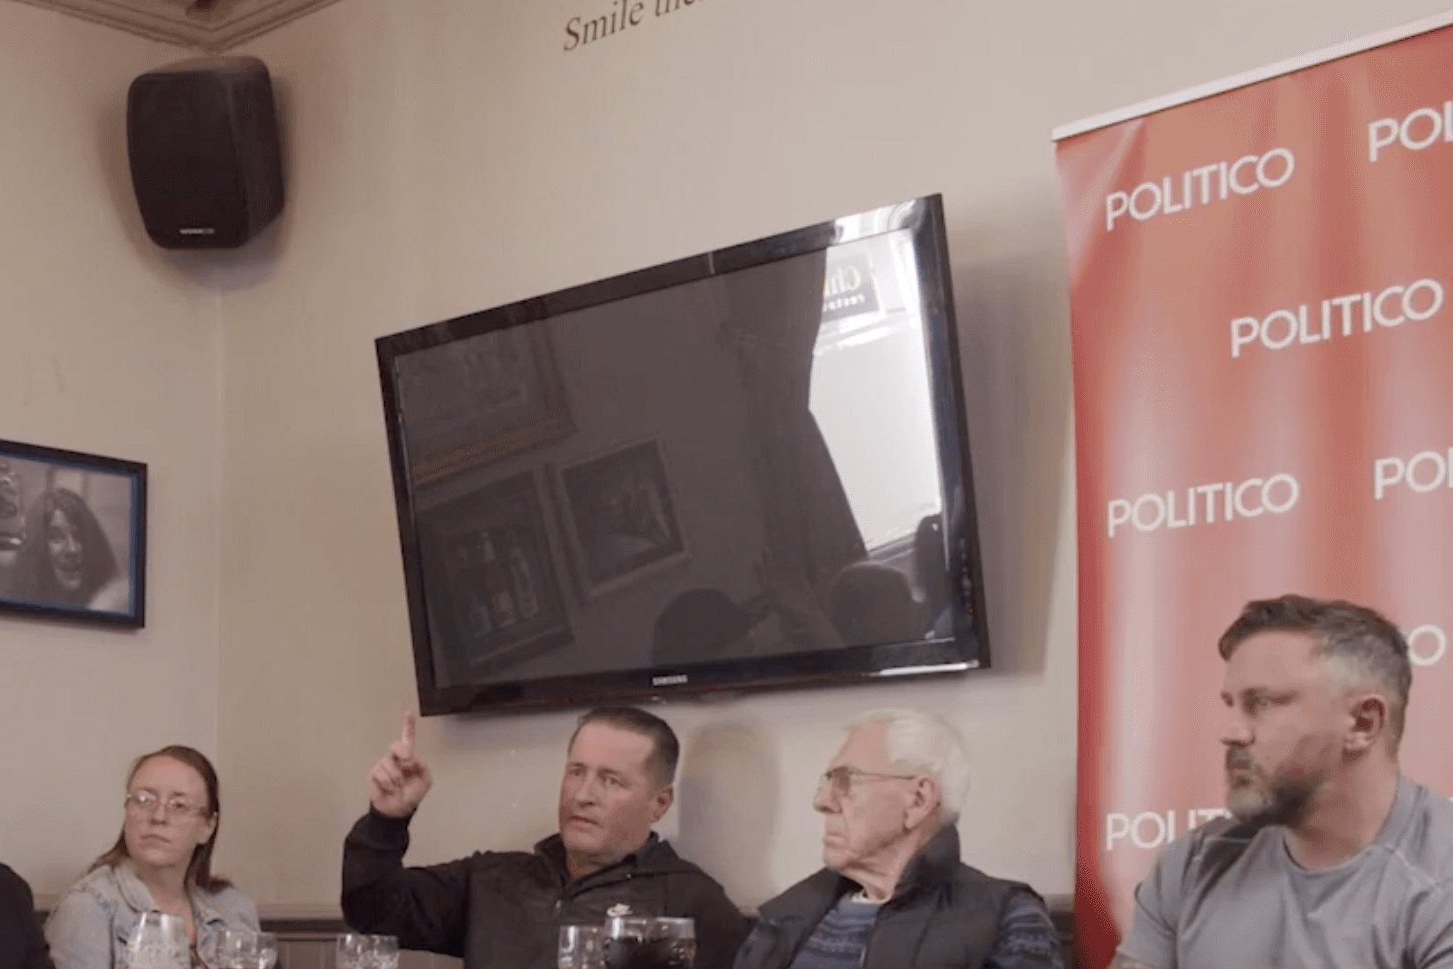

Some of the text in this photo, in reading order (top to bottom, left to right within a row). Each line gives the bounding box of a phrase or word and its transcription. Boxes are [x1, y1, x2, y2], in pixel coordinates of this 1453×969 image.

[563, 0, 644, 51] Smile
[1106, 147, 1294, 231] POLITICO
[1230, 279, 1444, 358] POLITICO
[1107, 473, 1299, 539] POLITICO
